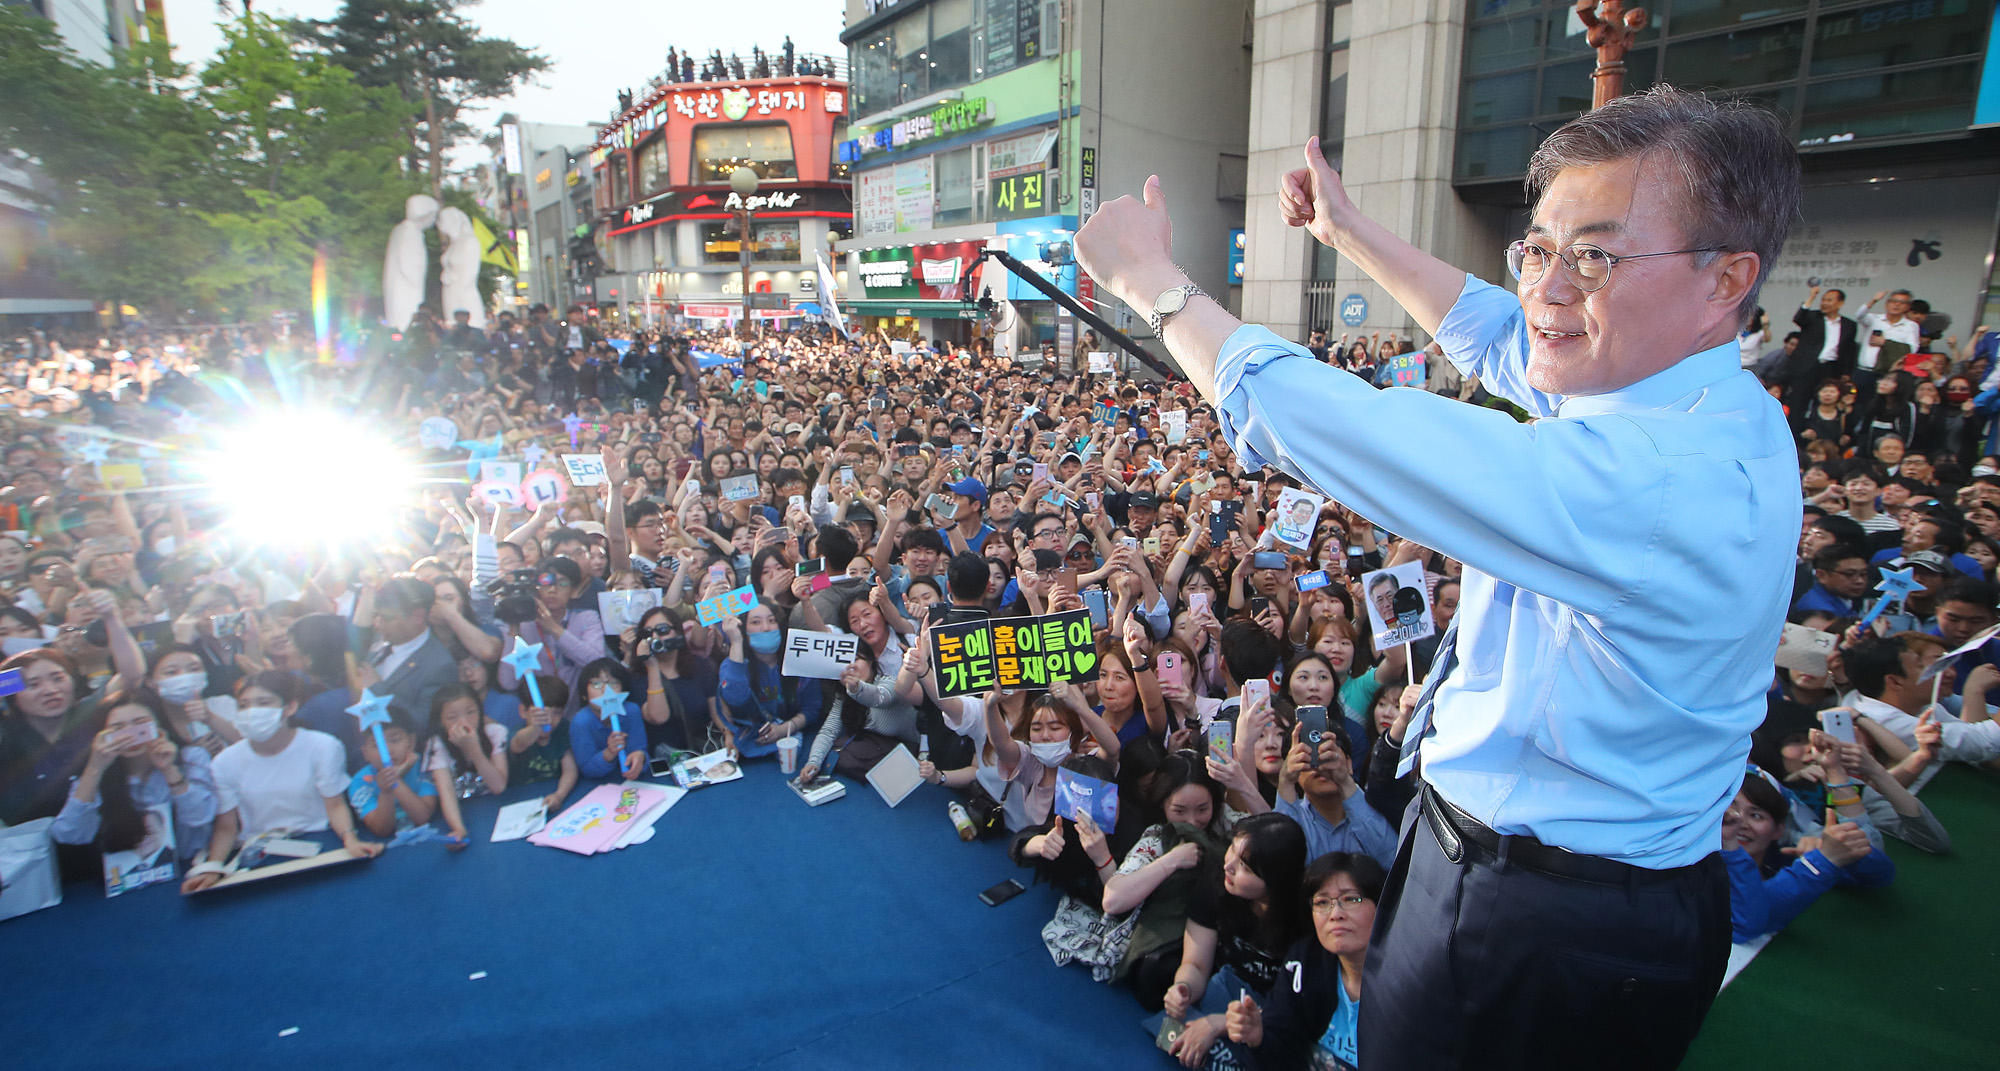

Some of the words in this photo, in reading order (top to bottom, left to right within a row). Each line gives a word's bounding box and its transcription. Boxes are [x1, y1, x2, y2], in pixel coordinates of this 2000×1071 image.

[674, 93, 718, 119] 착한
[758, 91, 804, 115] 돼지
[1083, 150, 1093, 177] 사진
[767, 191, 801, 208] Hut
[997, 173, 1042, 212] 사진
[1344, 304, 1364, 316] ADT
[1302, 574, 1322, 586] 투대문
[942, 658, 994, 693] 가도
[997, 651, 1072, 686] 문재인
